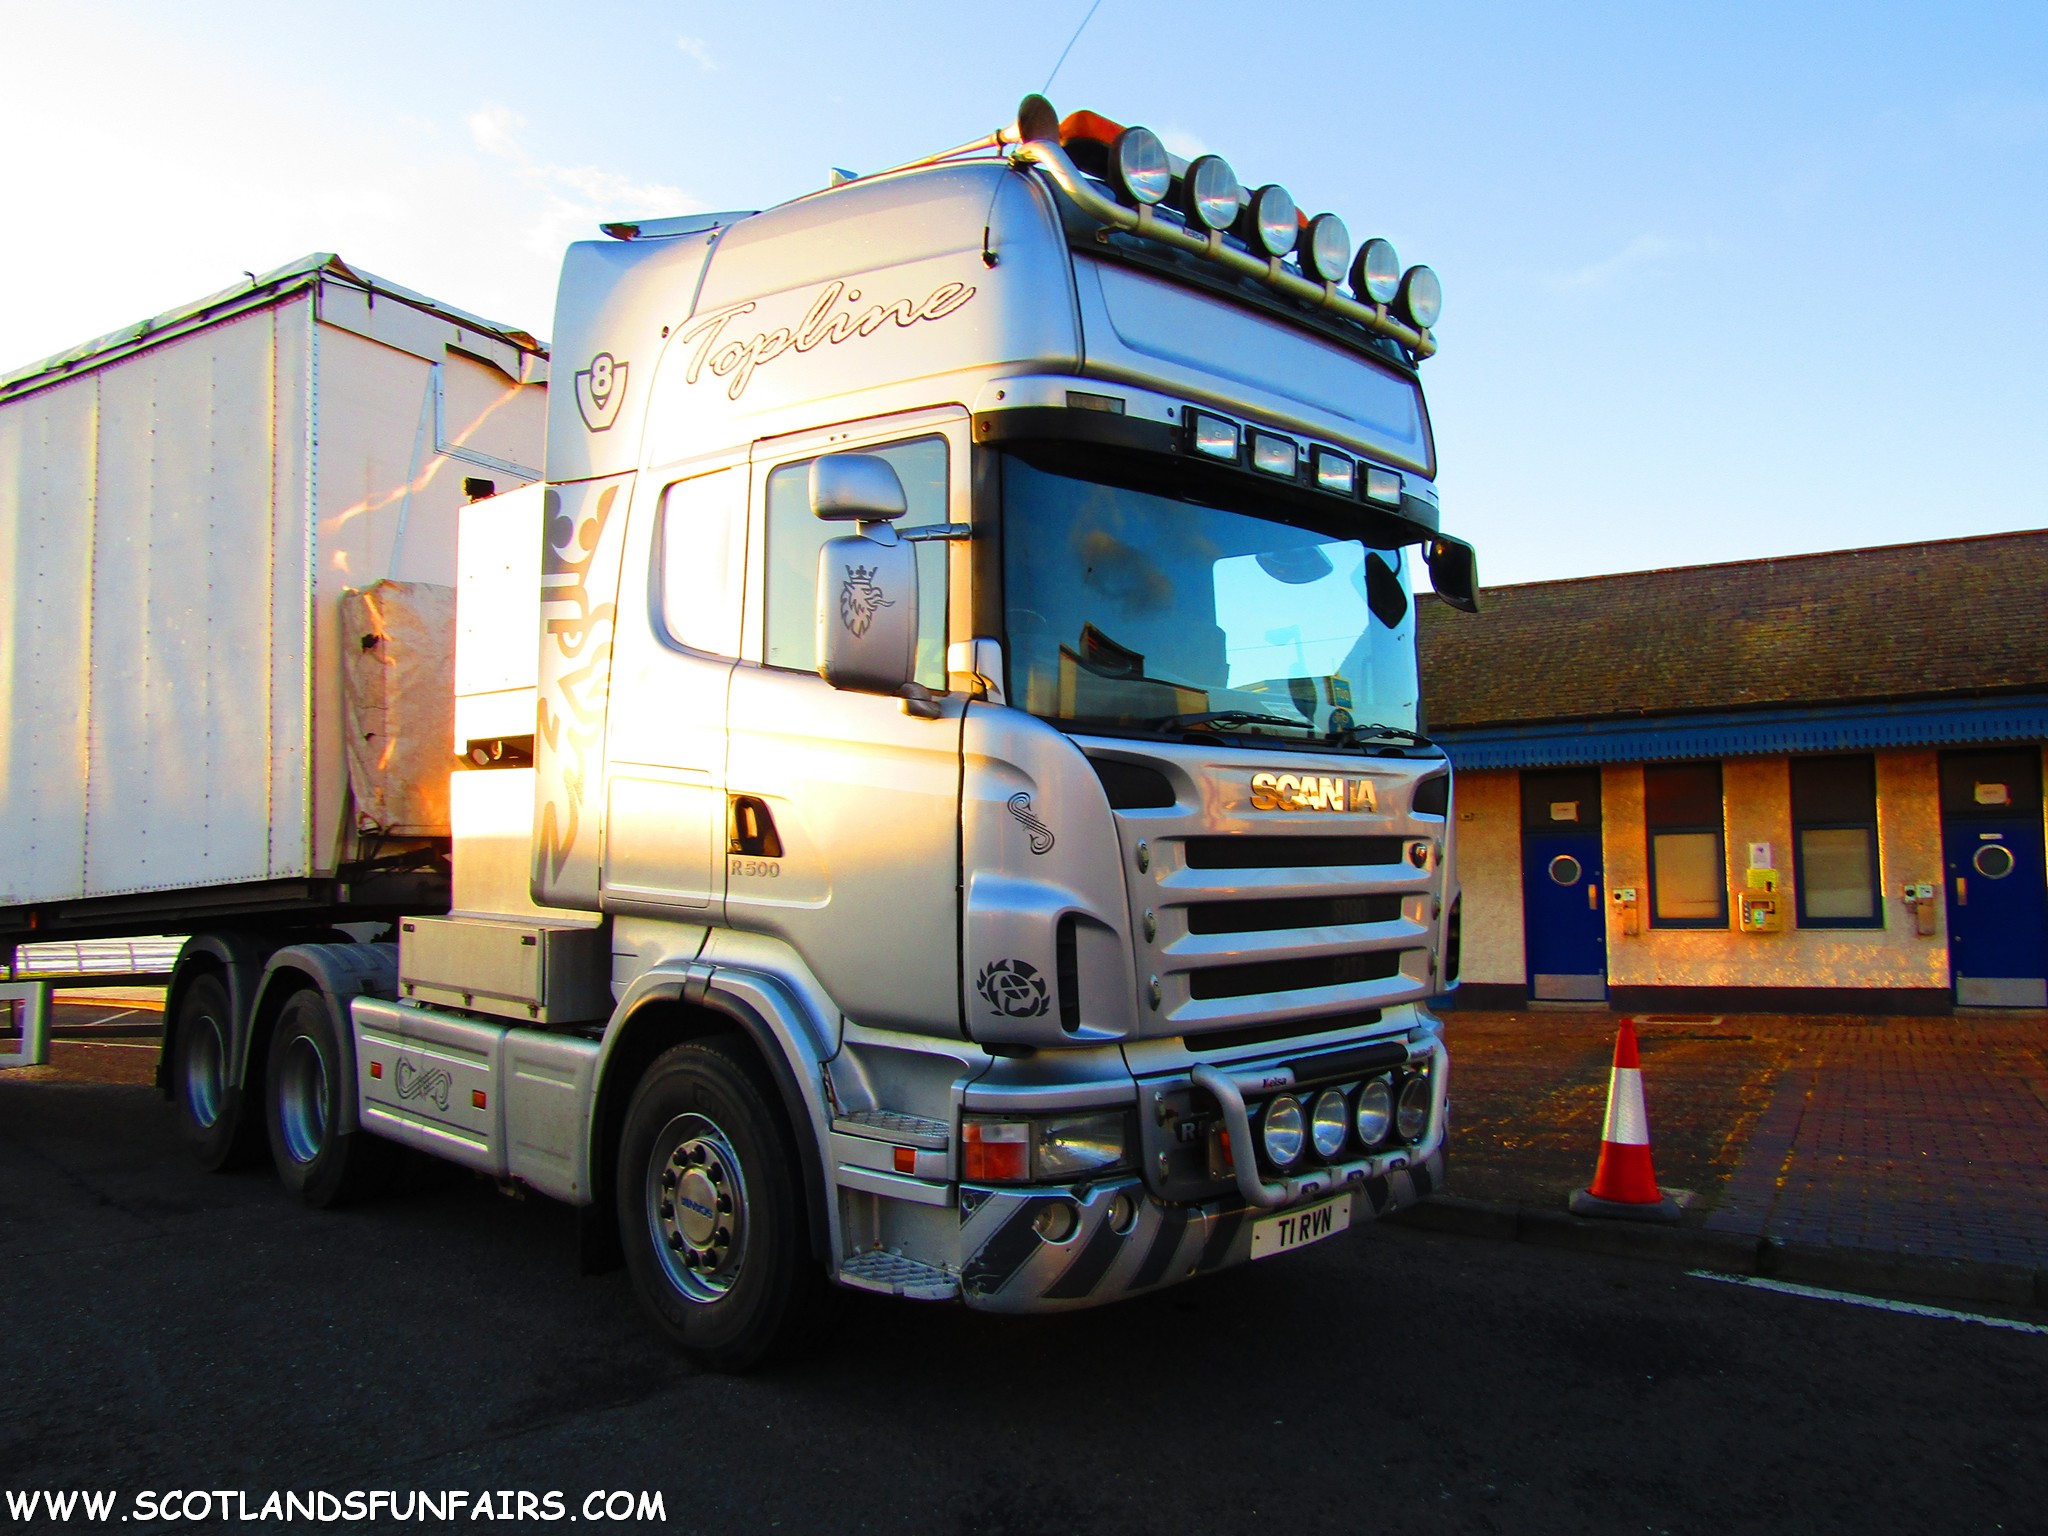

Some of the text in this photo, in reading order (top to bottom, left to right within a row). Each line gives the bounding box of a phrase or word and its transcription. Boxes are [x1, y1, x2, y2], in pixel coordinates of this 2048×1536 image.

[684, 281, 976, 400] Topline
[1251, 772, 1379, 813] SCANIA
[730, 859, 781, 878] R 500
[1299, 1205, 1332, 1242] RVN
